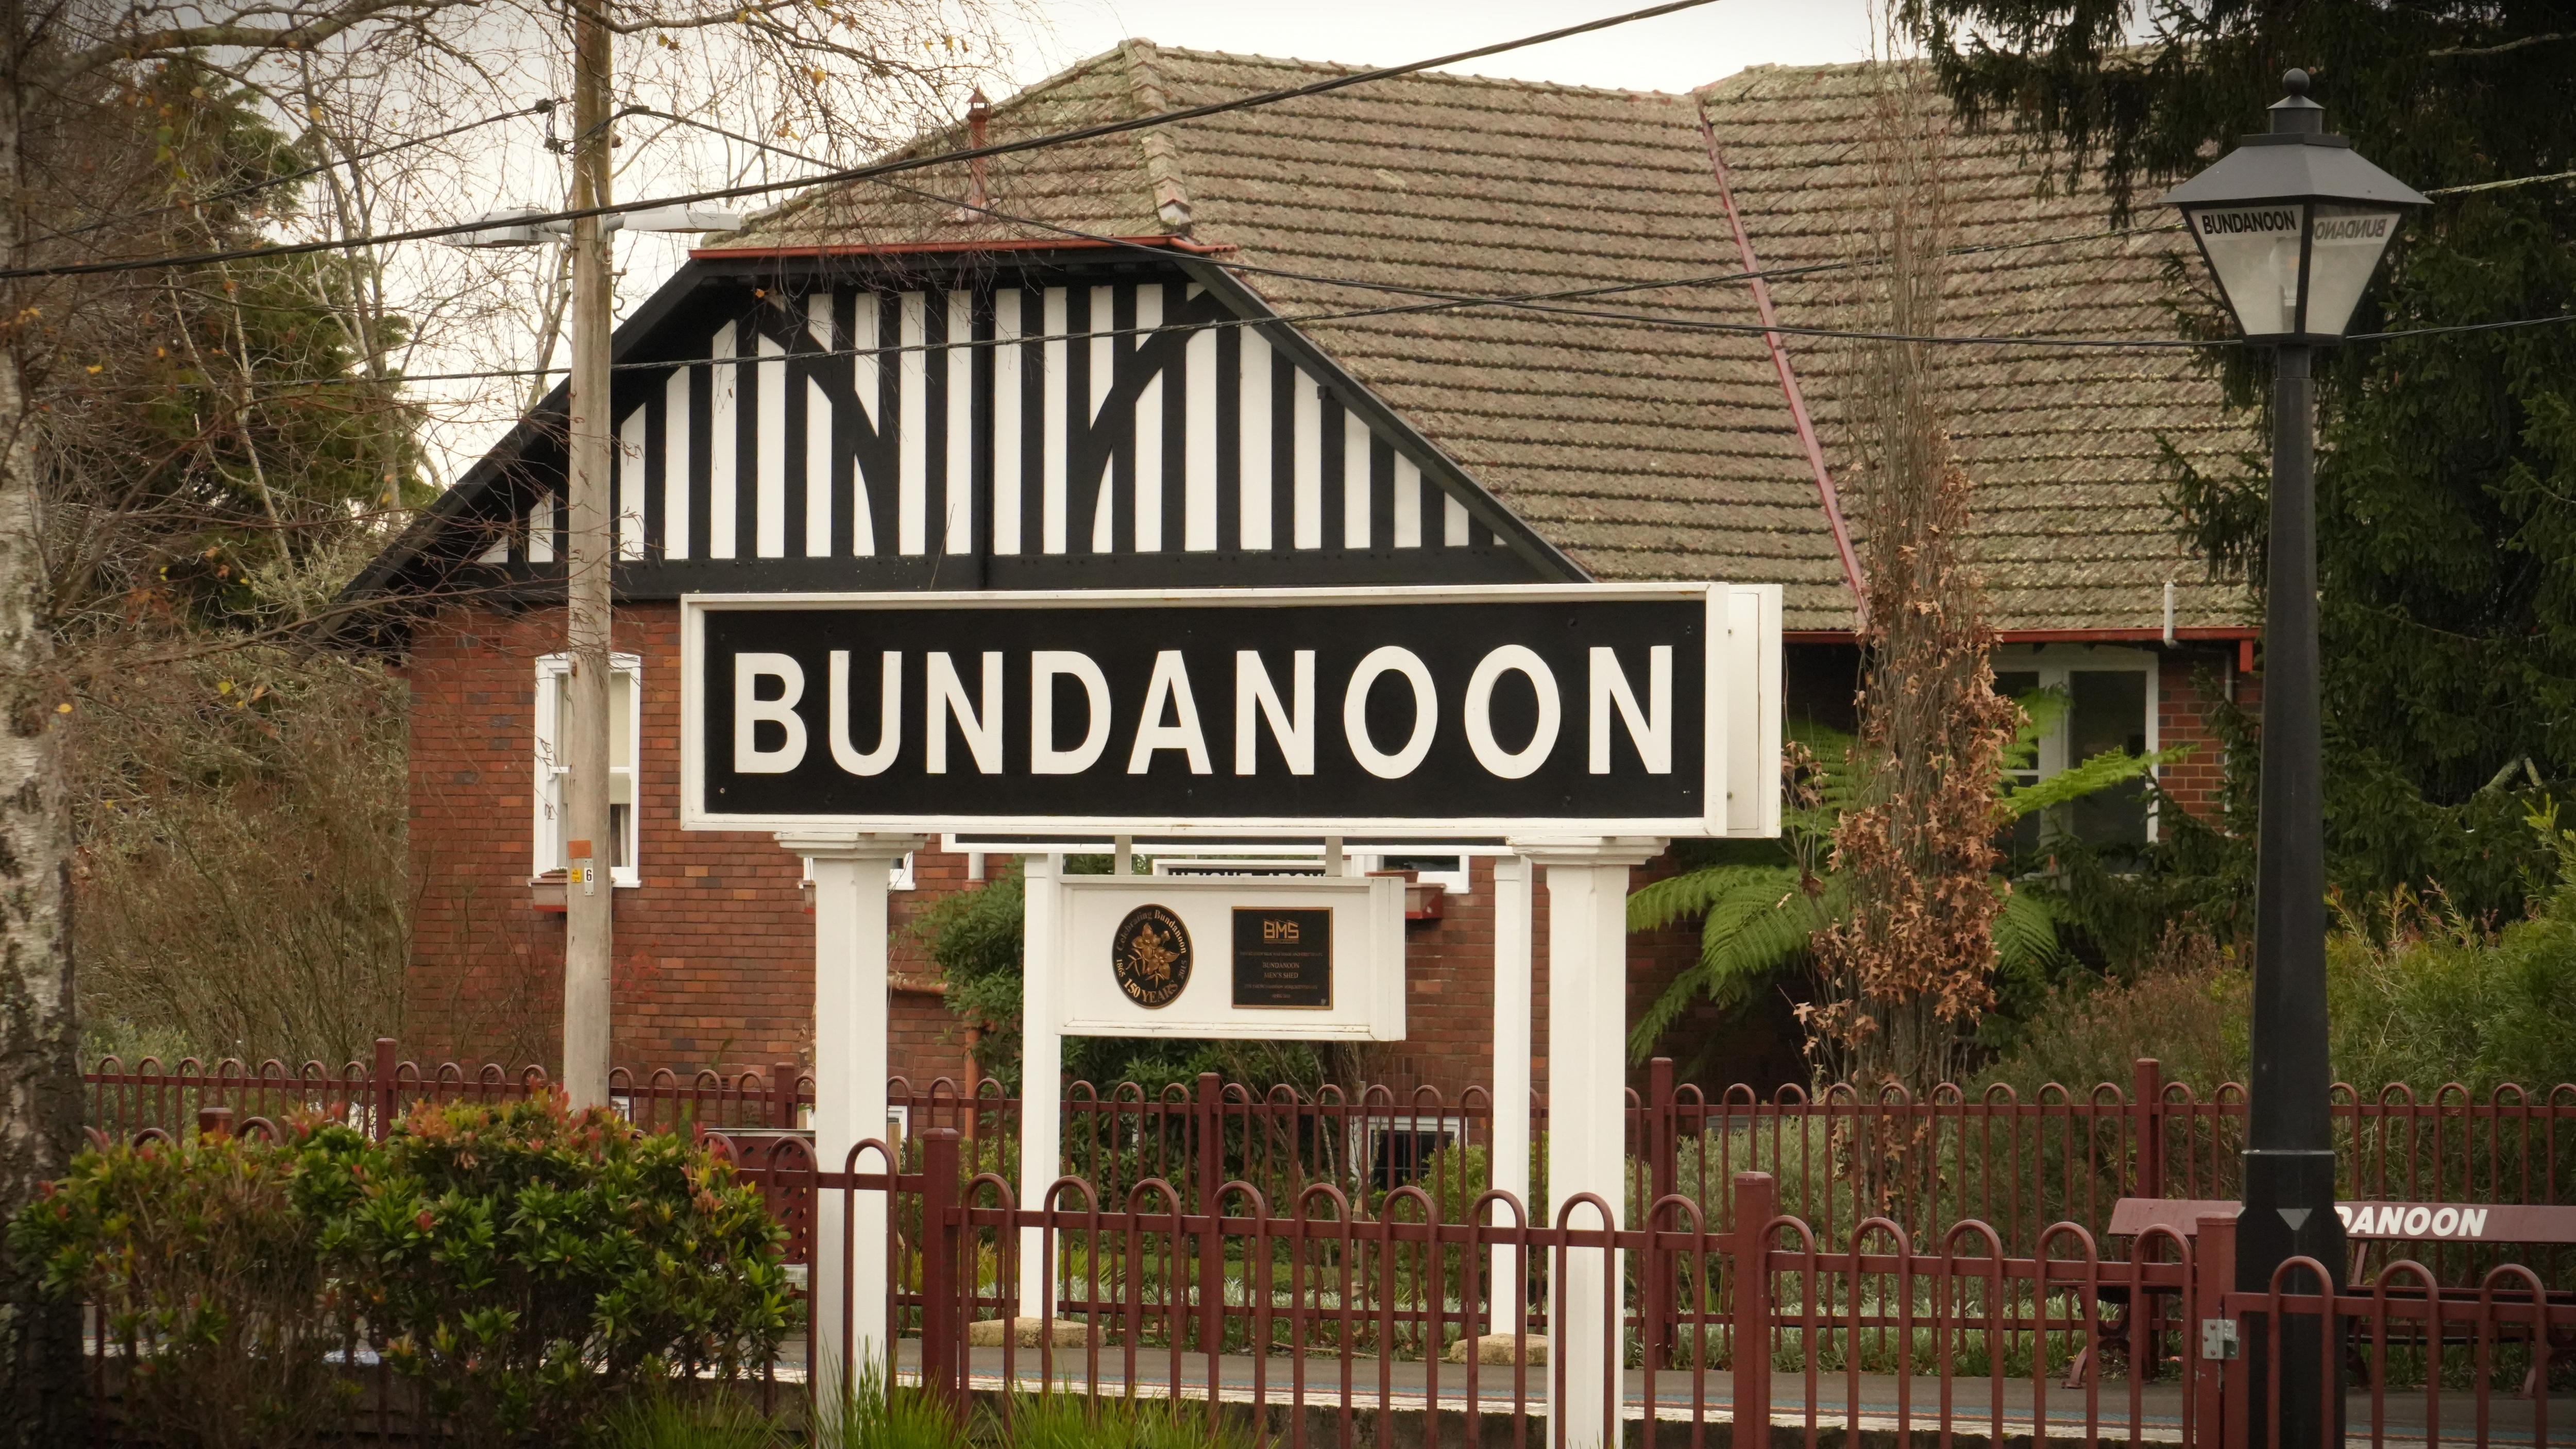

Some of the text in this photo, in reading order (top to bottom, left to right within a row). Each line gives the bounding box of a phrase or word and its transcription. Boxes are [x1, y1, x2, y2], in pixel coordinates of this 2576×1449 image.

[2201, 210, 2297, 235] BUNDANOON
[735, 644, 1672, 780] BUNDANOON
[586, 869, 592, 881] 6
[1116, 910, 1187, 954] Celebrating Bundanoon
[1264, 920, 1299, 939] BMS
[1116, 959, 1126, 978] 1865
[1178, 960, 1188, 980] 2015
[1124, 978, 1178, 1003] 150 YEARS
